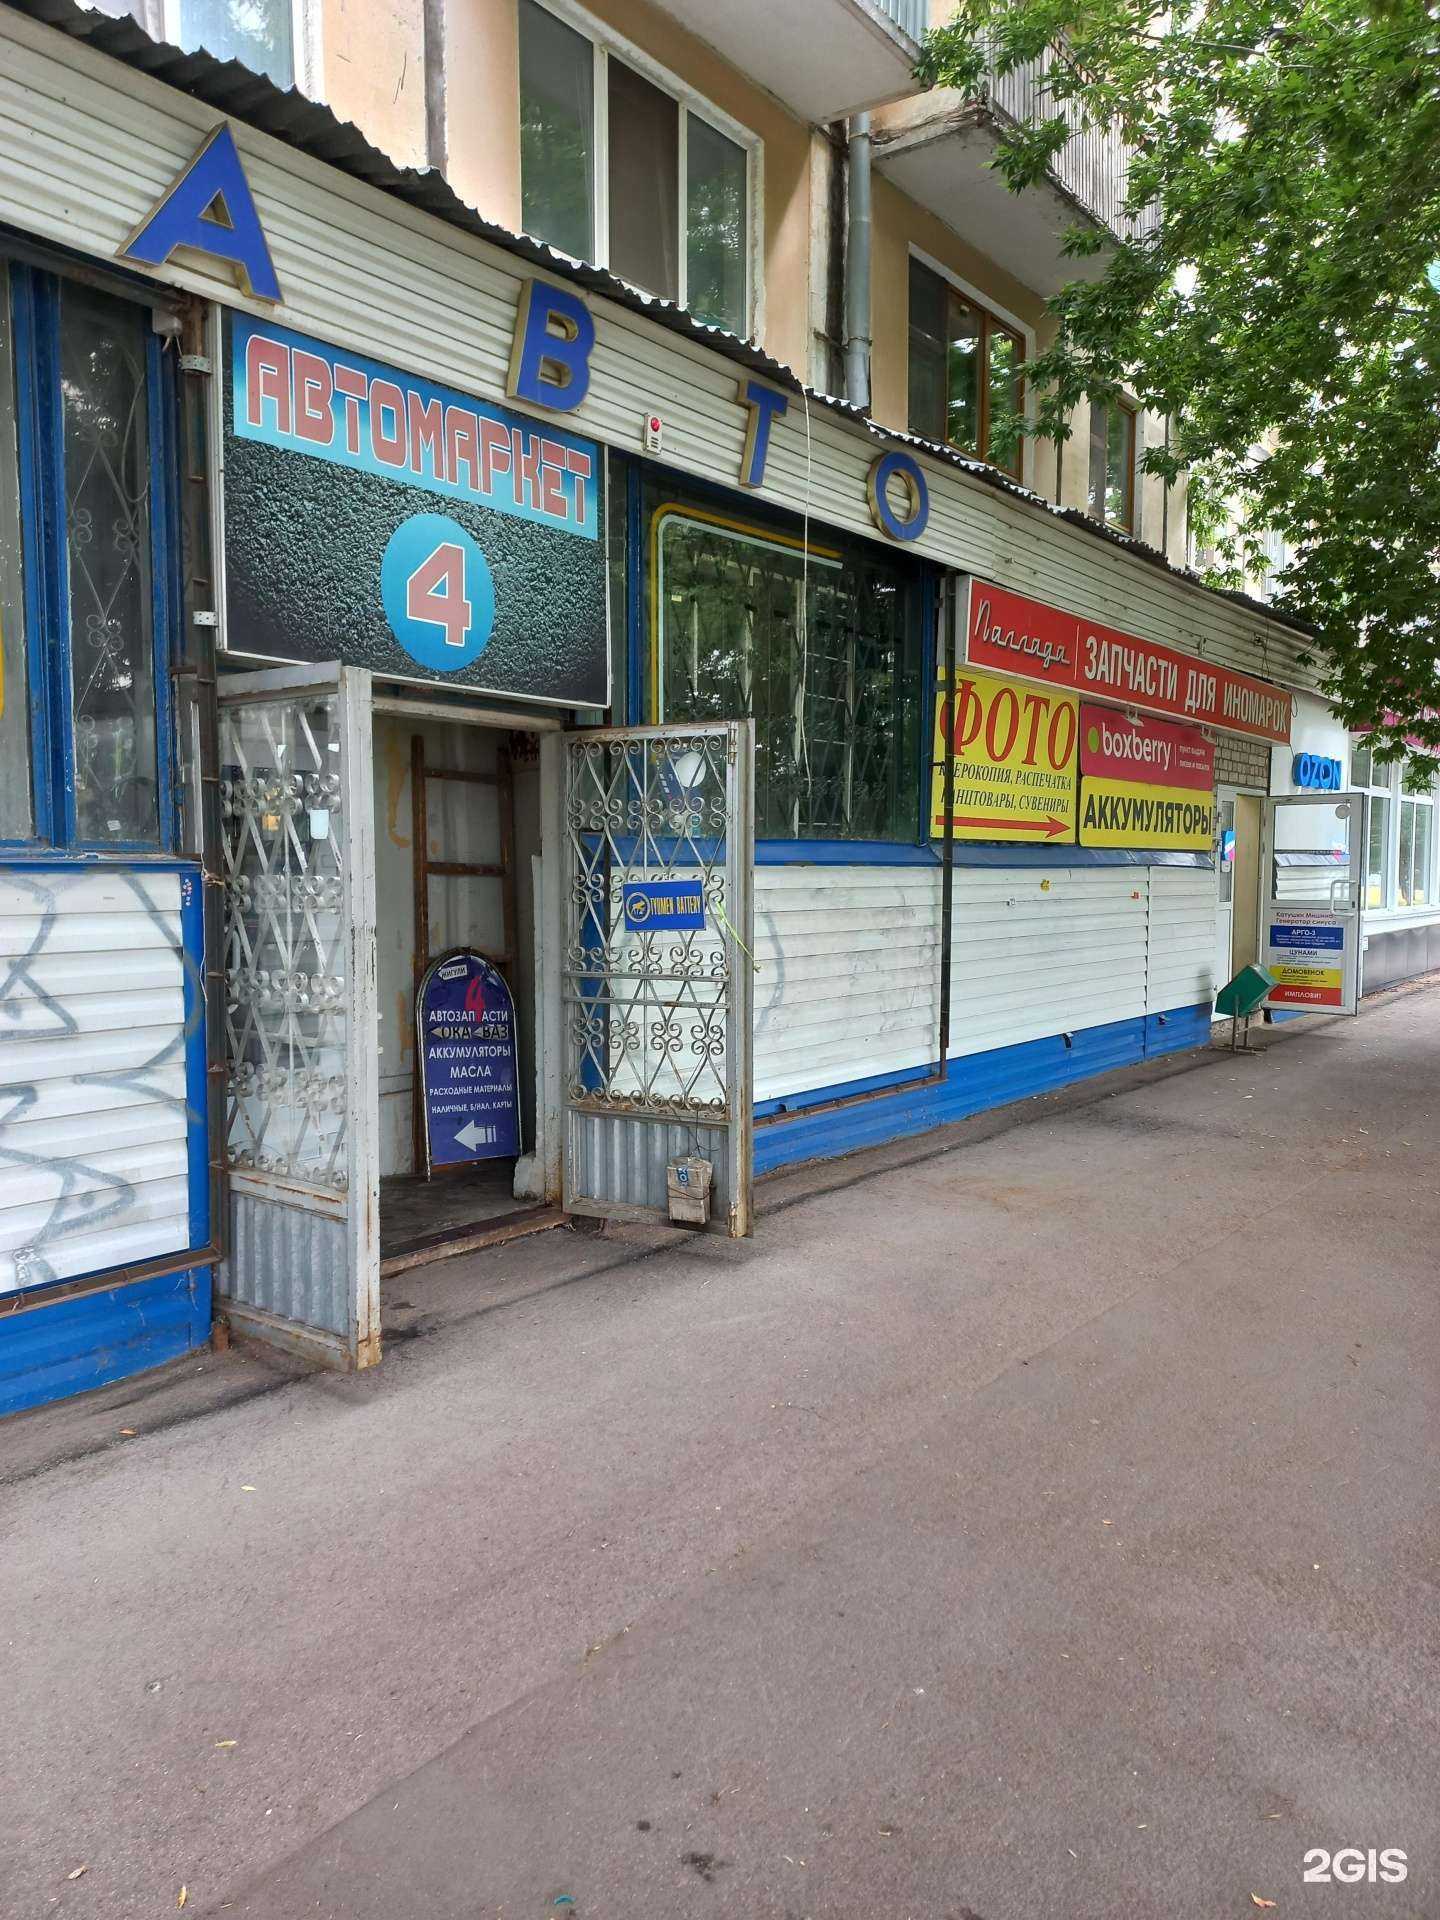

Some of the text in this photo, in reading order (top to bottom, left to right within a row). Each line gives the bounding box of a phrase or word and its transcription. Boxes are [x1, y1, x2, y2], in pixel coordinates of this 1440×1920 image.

[246, 335, 592, 525] АВТОМАРКЕТ
[407, 543, 471, 647] 4
[1084, 635, 1179, 702] ЗАПЧАСТИ
[1184, 669, 1217, 714] ДЛЯ
[1223, 681, 1288, 734] ИНОМАРОК
[939, 678, 1077, 770] ФОТО
[1102, 721, 1172, 771] boxberry
[1015, 770, 1072, 790] РАСПЕЧАТКА
[1296, 753, 1342, 790] OZON
[1018, 795, 1070, 813] СУВЕНИРЫ
[1083, 794, 1213, 836] АККУМУЛЯТОРЫ
[441, 1025, 508, 1039] ОКА ВАЗ
[428, 1046, 511, 1059] АККУМУЛЯТОРЫ
[450, 1065, 492, 1078] МАСЛА
[429, 1083, 513, 1096] РАСХОДНЫЕ МАТЕРИАЛЫ
[493, 1100, 513, 1110] КАРТЫ
